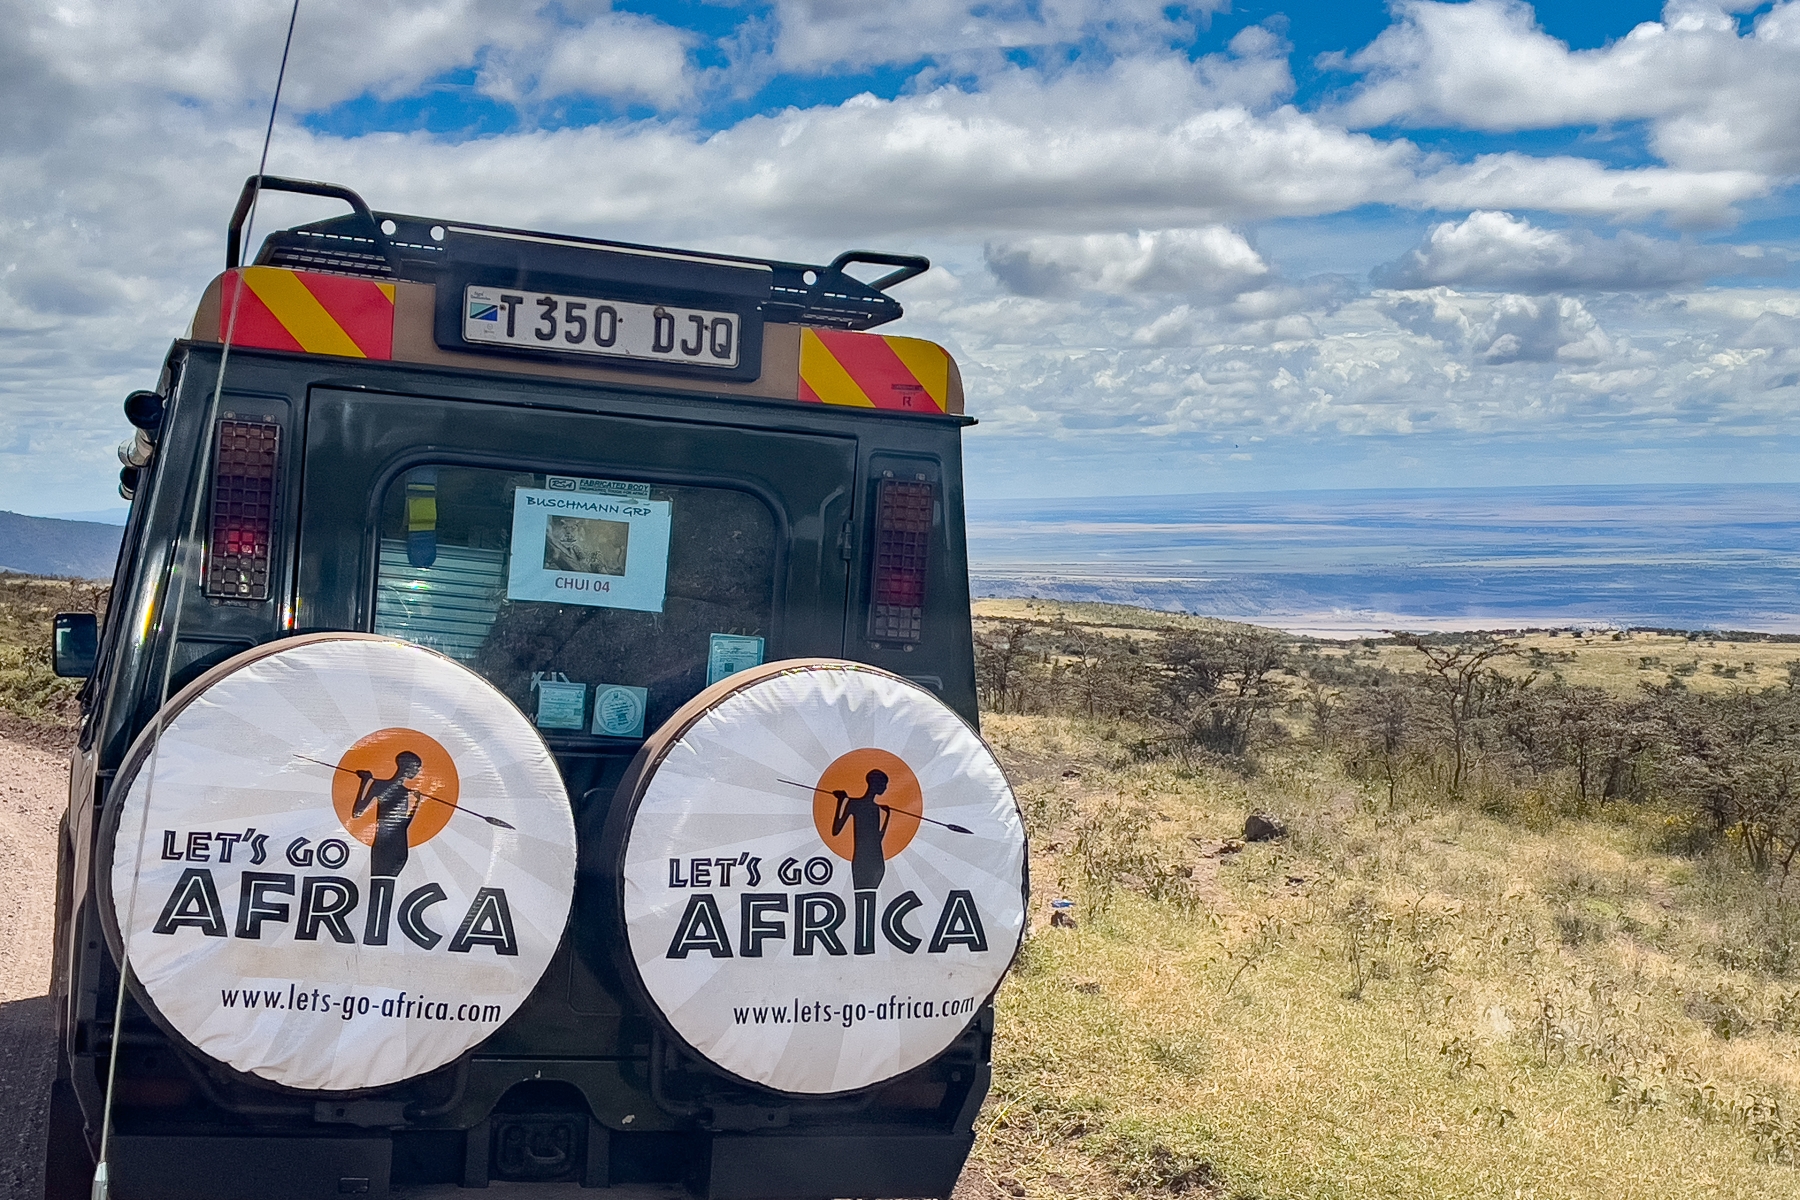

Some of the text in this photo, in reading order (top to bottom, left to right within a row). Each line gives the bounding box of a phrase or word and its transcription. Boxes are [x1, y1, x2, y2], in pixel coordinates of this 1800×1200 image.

[500, 294, 733, 359] T 350 DJQ
[580, 479, 649, 493] FABRICATED BODY
[526, 496, 651, 517] BUSCHMANN GRP
[555, 577, 610, 593] CHUI 04
[161, 828, 349, 869] LET'S GO
[668, 852, 834, 888] LET'S GO
[152, 868, 519, 956] AFRICA
[665, 889, 989, 959] AFRICA
[221, 984, 501, 1022] www.lets-go-africa.com
[733, 995, 975, 1028] www.lets-go-africa.com
